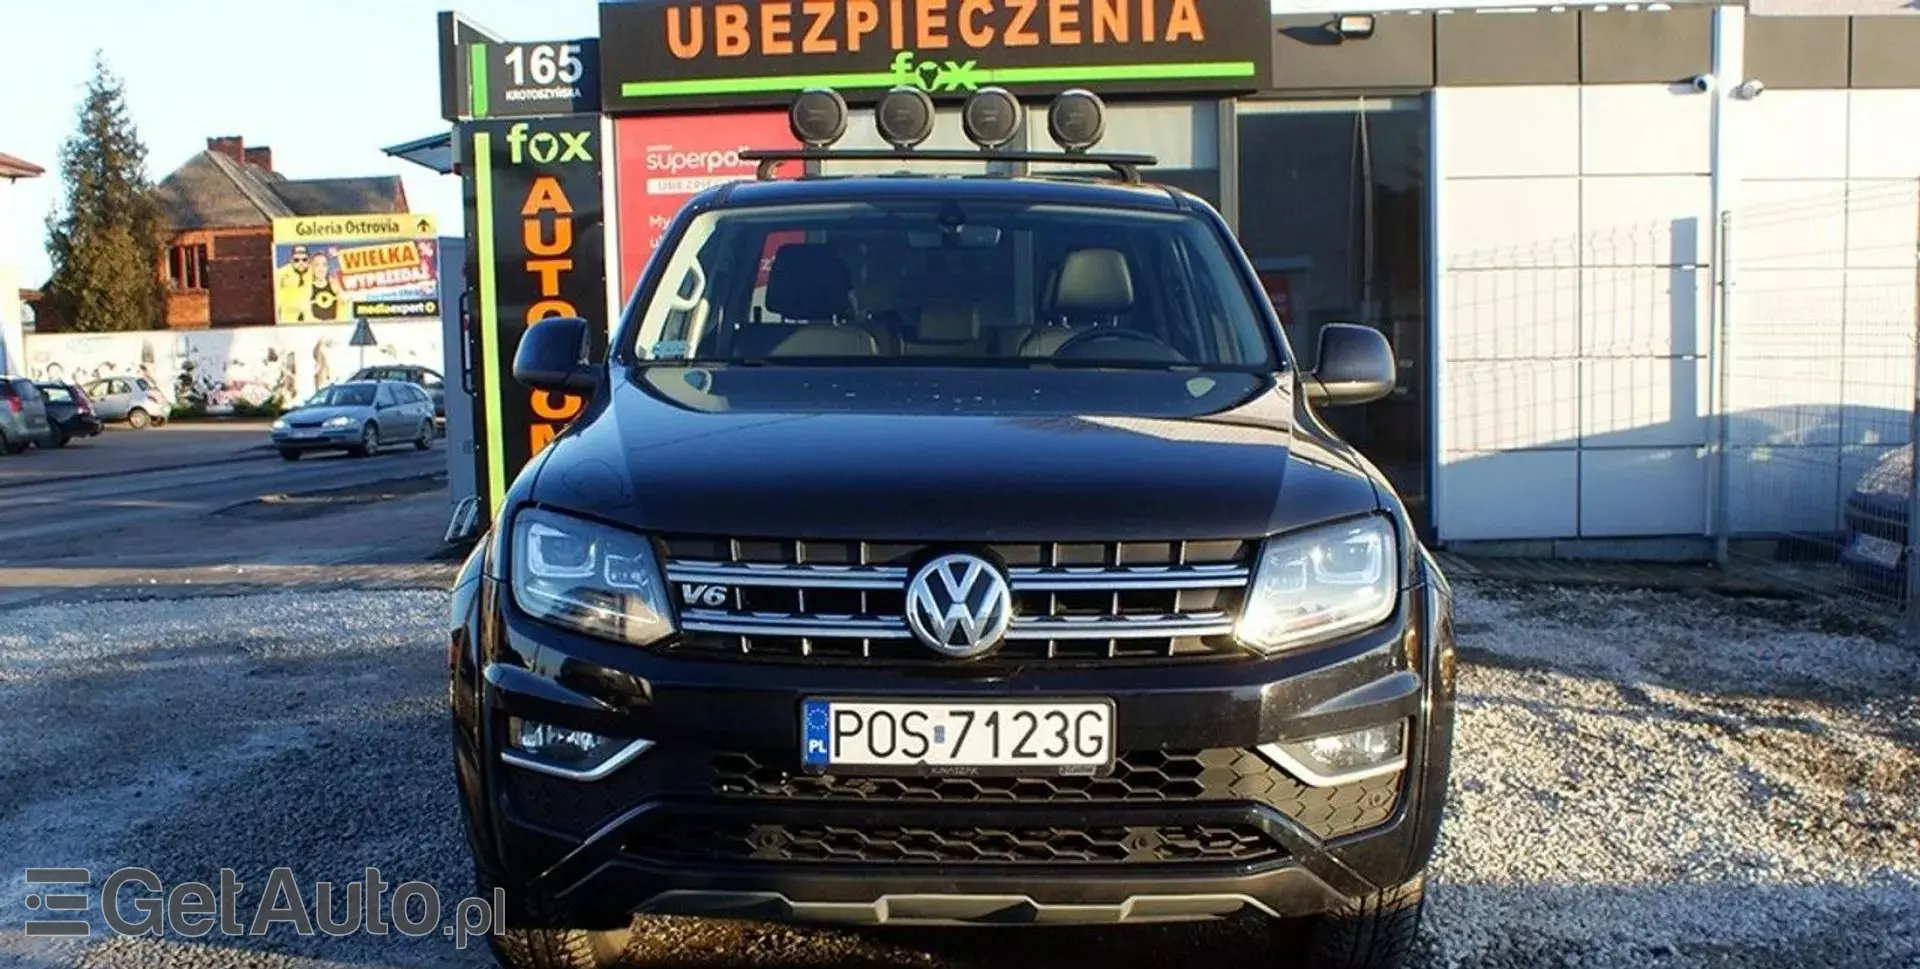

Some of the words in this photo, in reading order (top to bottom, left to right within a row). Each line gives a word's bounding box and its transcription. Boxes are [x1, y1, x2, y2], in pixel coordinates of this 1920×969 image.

[666, 0, 1205, 58] UBEZPIECZENIA
[505, 45, 583, 85] 165
[891, 53, 978, 92] fox
[506, 123, 593, 164] fox
[295, 220, 343, 236] Galeria
[345, 217, 400, 233] Ostrovia
[343, 245, 415, 269] WIELKA
[357, 302, 424, 315] mediaexpert
[681, 584, 727, 606] V6
[809, 739, 827, 753] PL
[833, 710, 930, 759] POS
[949, 710, 1105, 759] 7123G
